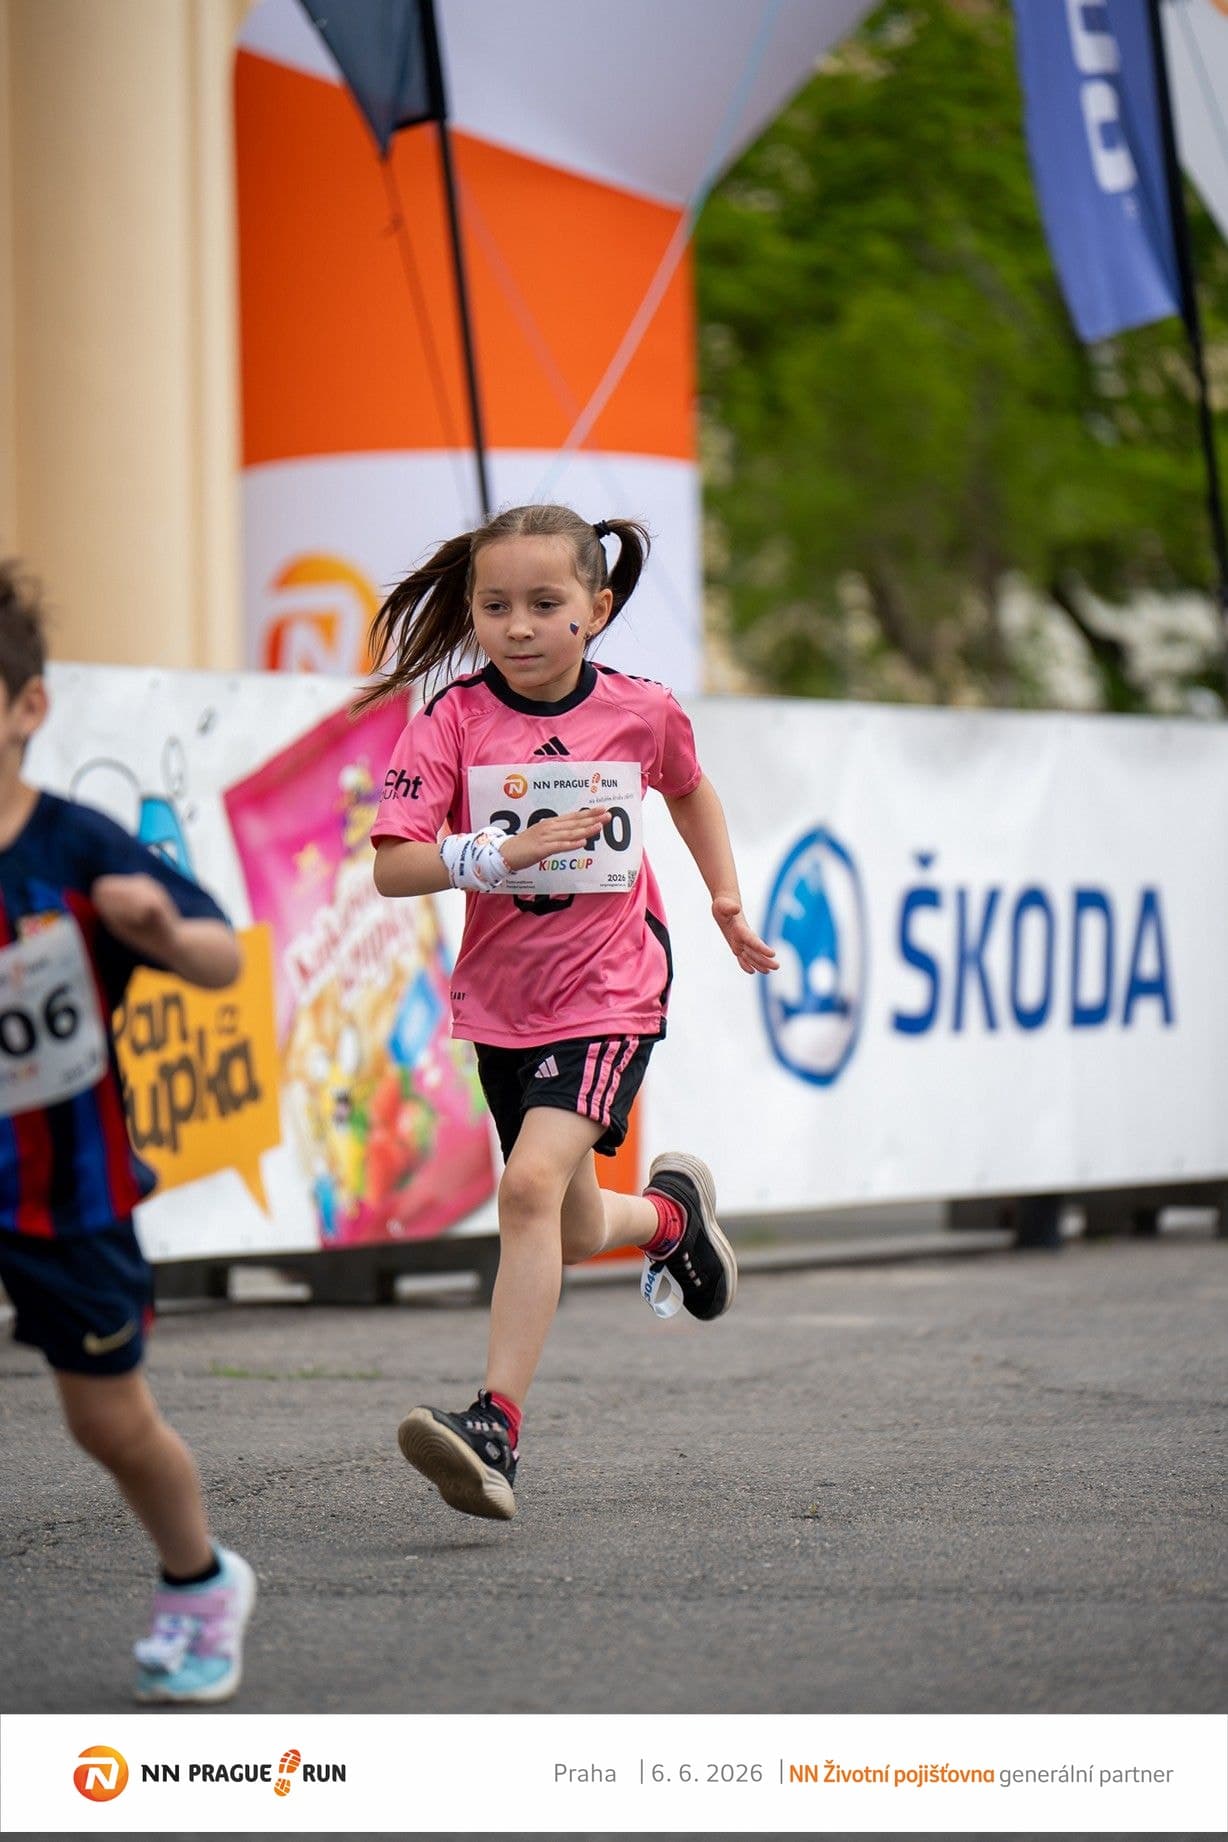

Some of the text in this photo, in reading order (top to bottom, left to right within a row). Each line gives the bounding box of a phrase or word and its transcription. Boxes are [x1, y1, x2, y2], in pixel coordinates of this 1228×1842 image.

[533, 779, 618, 790] NN PRAGUE RUN
[539, 858, 593, 871] KIDS CUP
[607, 873, 627, 882] 2026
[892, 851, 1176, 1035] ŠKODA
